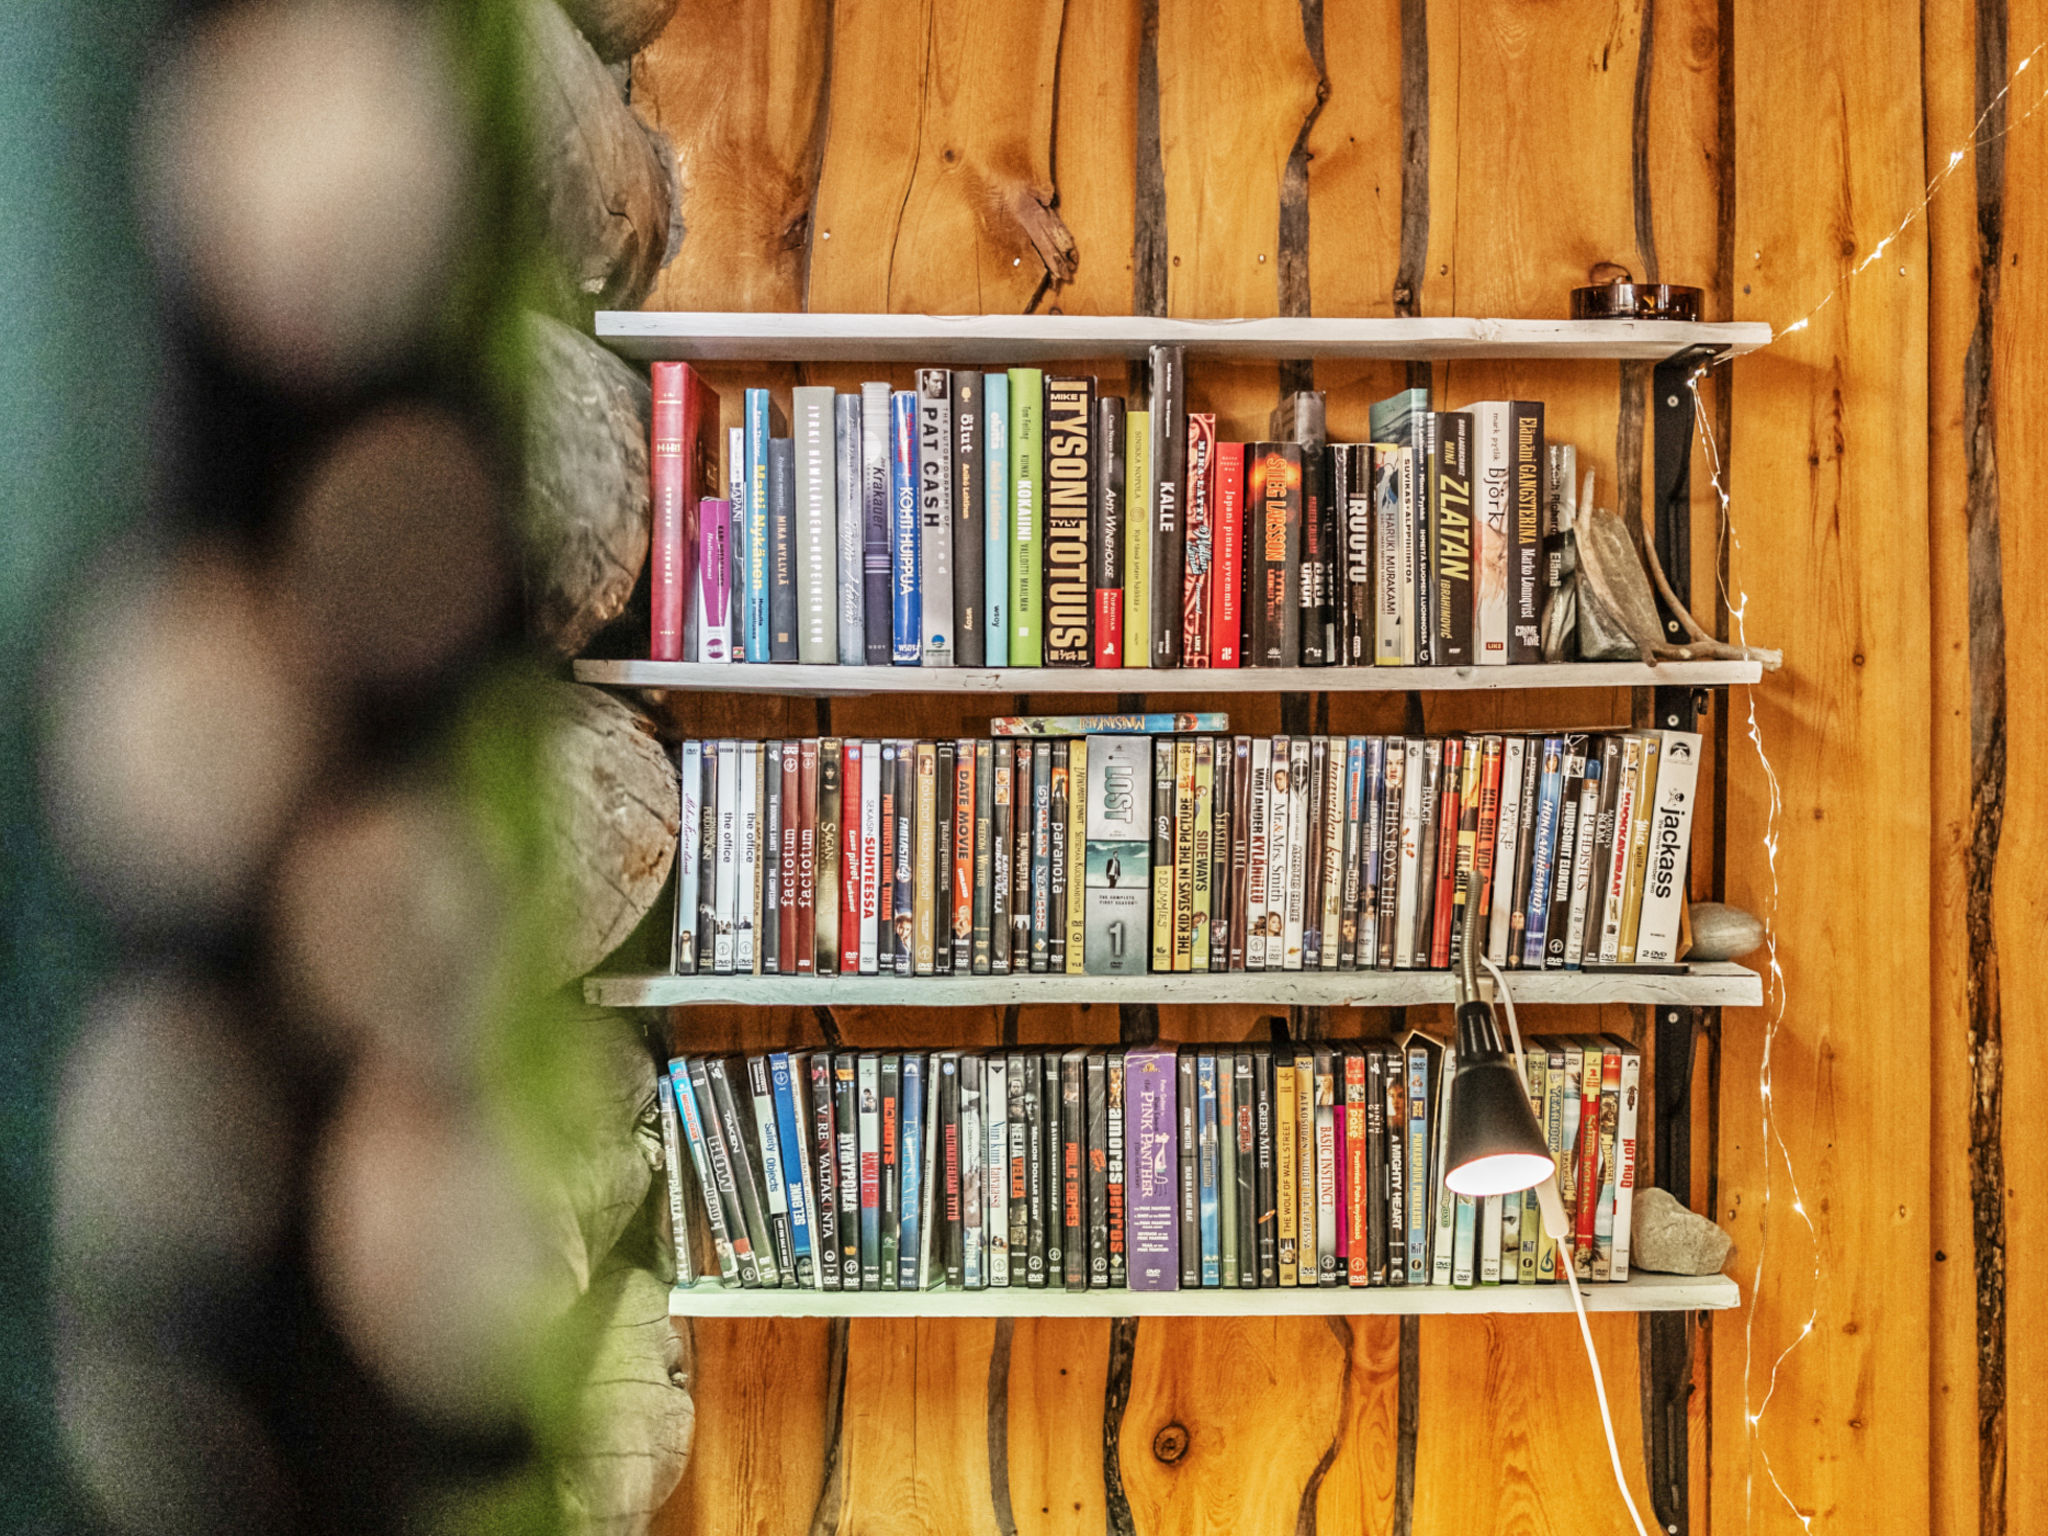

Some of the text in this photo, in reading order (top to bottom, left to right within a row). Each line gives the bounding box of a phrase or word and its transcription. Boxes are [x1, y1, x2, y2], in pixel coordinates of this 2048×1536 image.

[1050, 393, 1079, 401] MIKE
[1492, 412, 1500, 434] mark
[922, 407, 940, 527] PAT CASH
[1134, 430, 1143, 499] SINIKKA NOPOLA
[1196, 440, 1207, 476] MIKA
[1517, 416, 1538, 544] Elämäni GANGSTERINA
[750, 464, 766, 589] Matti Nykänen
[808, 405, 824, 643] JYRKI HÄMÄLÄINEN KUU
[873, 467, 887, 531] Krakauer
[898, 486, 915, 530] KOHTI
[944, 515, 951, 528] OF
[1050, 519, 1079, 528] TYLY
[1159, 481, 1175, 532] KALLE
[1265, 457, 1287, 562] STIEG LARSSON
[1483, 467, 1507, 525] björk
[778, 516, 789, 586] MIKA MYLLYLÄ
[898, 534, 915, 597] HUIPPUA
[1017, 454, 1033, 613] KUINKA KOKAIINI VALLOITTI MAAILMAN
[1104, 487, 1118, 579] AMY WINEHOUSE
[1221, 490, 1236, 621] Japani pintaa syvemmältä
[1349, 499, 1368, 583] RUUTU
[1385, 513, 1396, 615] HARUKI MURAKAMI
[1404, 511, 1412, 584] ALPPIHIIHTOA
[1420, 529, 1428, 562] IHMEITÄ
[1439, 440, 1470, 639] MINÄ ZLATAN IBRAHIMOVIĆ
[1518, 548, 1536, 619] Marko Lönnqvist
[1549, 552, 1562, 587] Elämä
[963, 607, 974, 631] wsoy
[991, 605, 1001, 628] wsoy
[958, 770, 970, 860] DATE MOVIE
[1104, 765, 1134, 825] LOST
[1157, 815, 1170, 842] Golf
[1274, 803, 1286, 824] Mr.
[1596, 812, 1609, 844] ROOM
[724, 812, 733, 863] the office
[745, 812, 755, 863] the office
[864, 799, 876, 919] SEKAISIN SUHTEESSA
[1051, 821, 1066, 894] paranoia
[1195, 830, 1210, 892] SIDEWAYS
[1214, 811, 1231, 863] SENSATION
[1250, 768, 1267, 904] WALLANDER KYLÄHULLU
[1272, 834, 1285, 861] Mrs.
[1381, 798, 1400, 918] THIS BOY'S LIFE
[1479, 817, 1495, 843] BILL
[1555, 801, 1578, 902] DUUDSONIT ELOKUVA
[1576, 813, 1597, 892] PUHDISTUS
[1655, 806, 1686, 899] jackass
[780, 829, 796, 907] factotum
[798, 829, 813, 908] factotum
[845, 851, 860, 881] pilvet
[1177, 797, 1193, 956] THE KID STAYS IN THE PICTURE
[1270, 864, 1284, 902] Smith
[1651, 857, 1659, 881] number
[1157, 876, 1169, 927] DUMMIES
[1109, 920, 1125, 958] 1
[724, 1109, 741, 1153] TAKEN
[1140, 1090, 1155, 1198] PINK PANTHER
[1258, 1102, 1271, 1168] GREEN MILE
[1549, 1085, 1563, 1153] YEARBOOK
[707, 1136, 734, 1193] BLOW
[764, 1122, 780, 1193] Safety Objects
[816, 1103, 834, 1239] VEREN VALTAKUNTA
[990, 1167, 1006, 1209] taivaassa
[1031, 1125, 1039, 1221] MILLION DOLLAR BABY
[1064, 1142, 1080, 1227] PUBLIC ENEMIES
[1107, 1107, 1124, 1253] amores perros
[1282, 1121, 1291, 1234] THE WOLF OF WALL STREET
[1319, 1126, 1334, 1208] BASIC INSTINCT
[1391, 1134, 1402, 1231] A MIGHTY HEART
[1620, 1138, 1636, 1189] HOT ROD
[705, 1189, 720, 1220] DEAD
